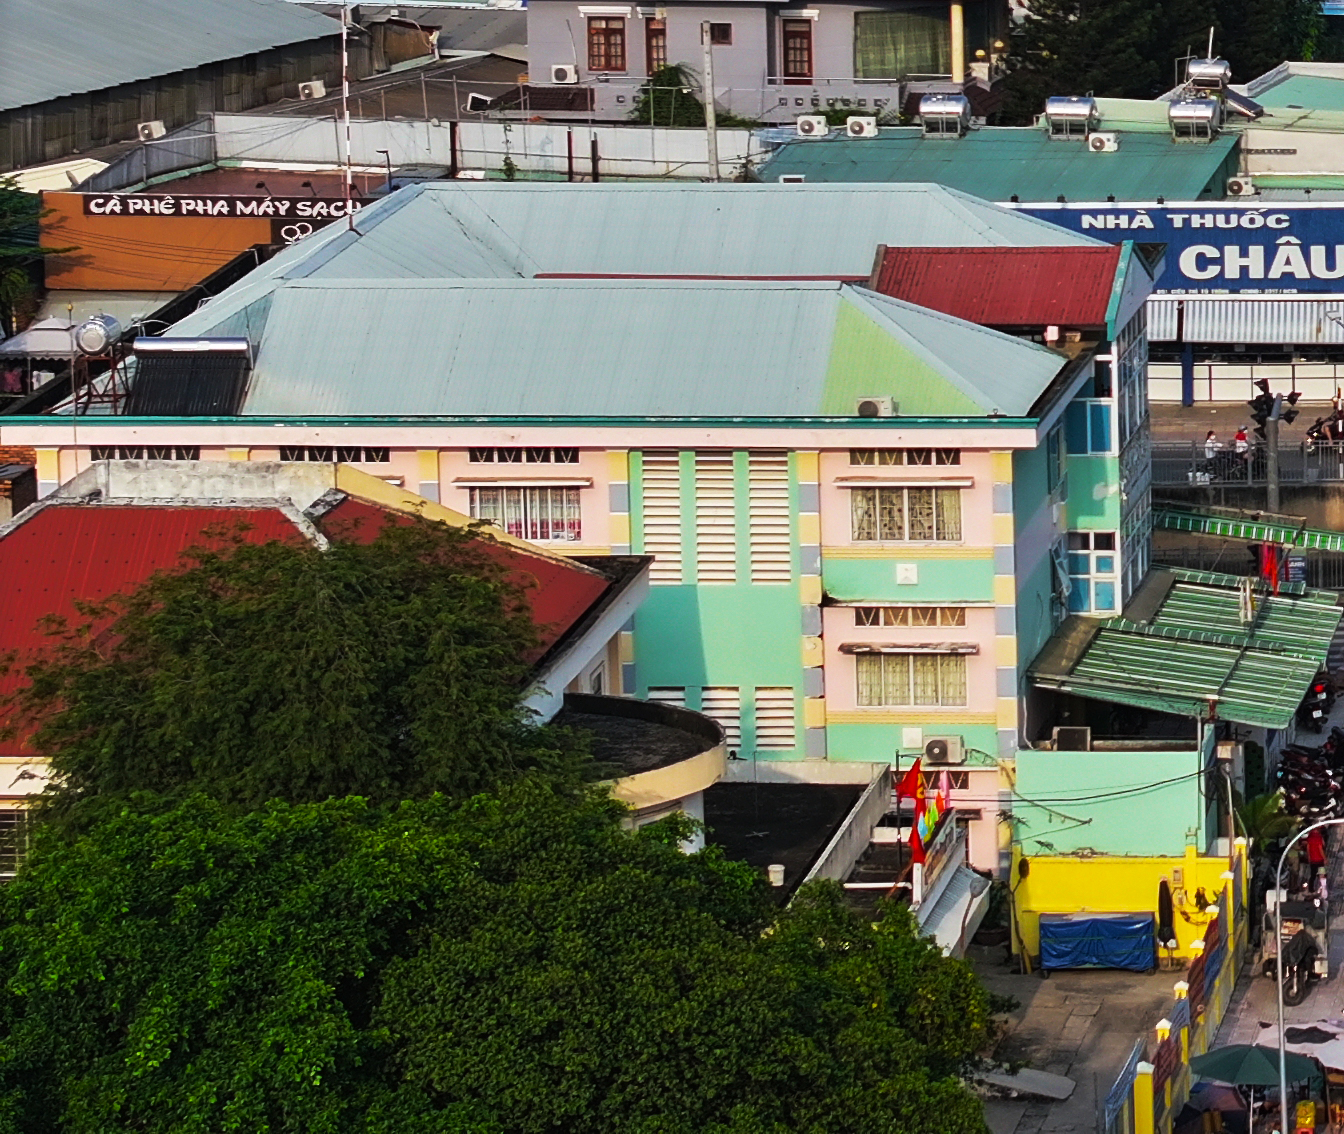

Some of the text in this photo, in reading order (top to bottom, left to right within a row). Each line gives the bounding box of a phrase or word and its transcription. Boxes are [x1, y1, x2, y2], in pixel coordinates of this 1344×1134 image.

[90, 195, 122, 214] CÀ
[127, 196, 175, 215] PHÊ
[180, 198, 230, 216] PHA
[235, 196, 290, 216] MÁY
[1081, 208, 1290, 229] NHÀ THUỐC
